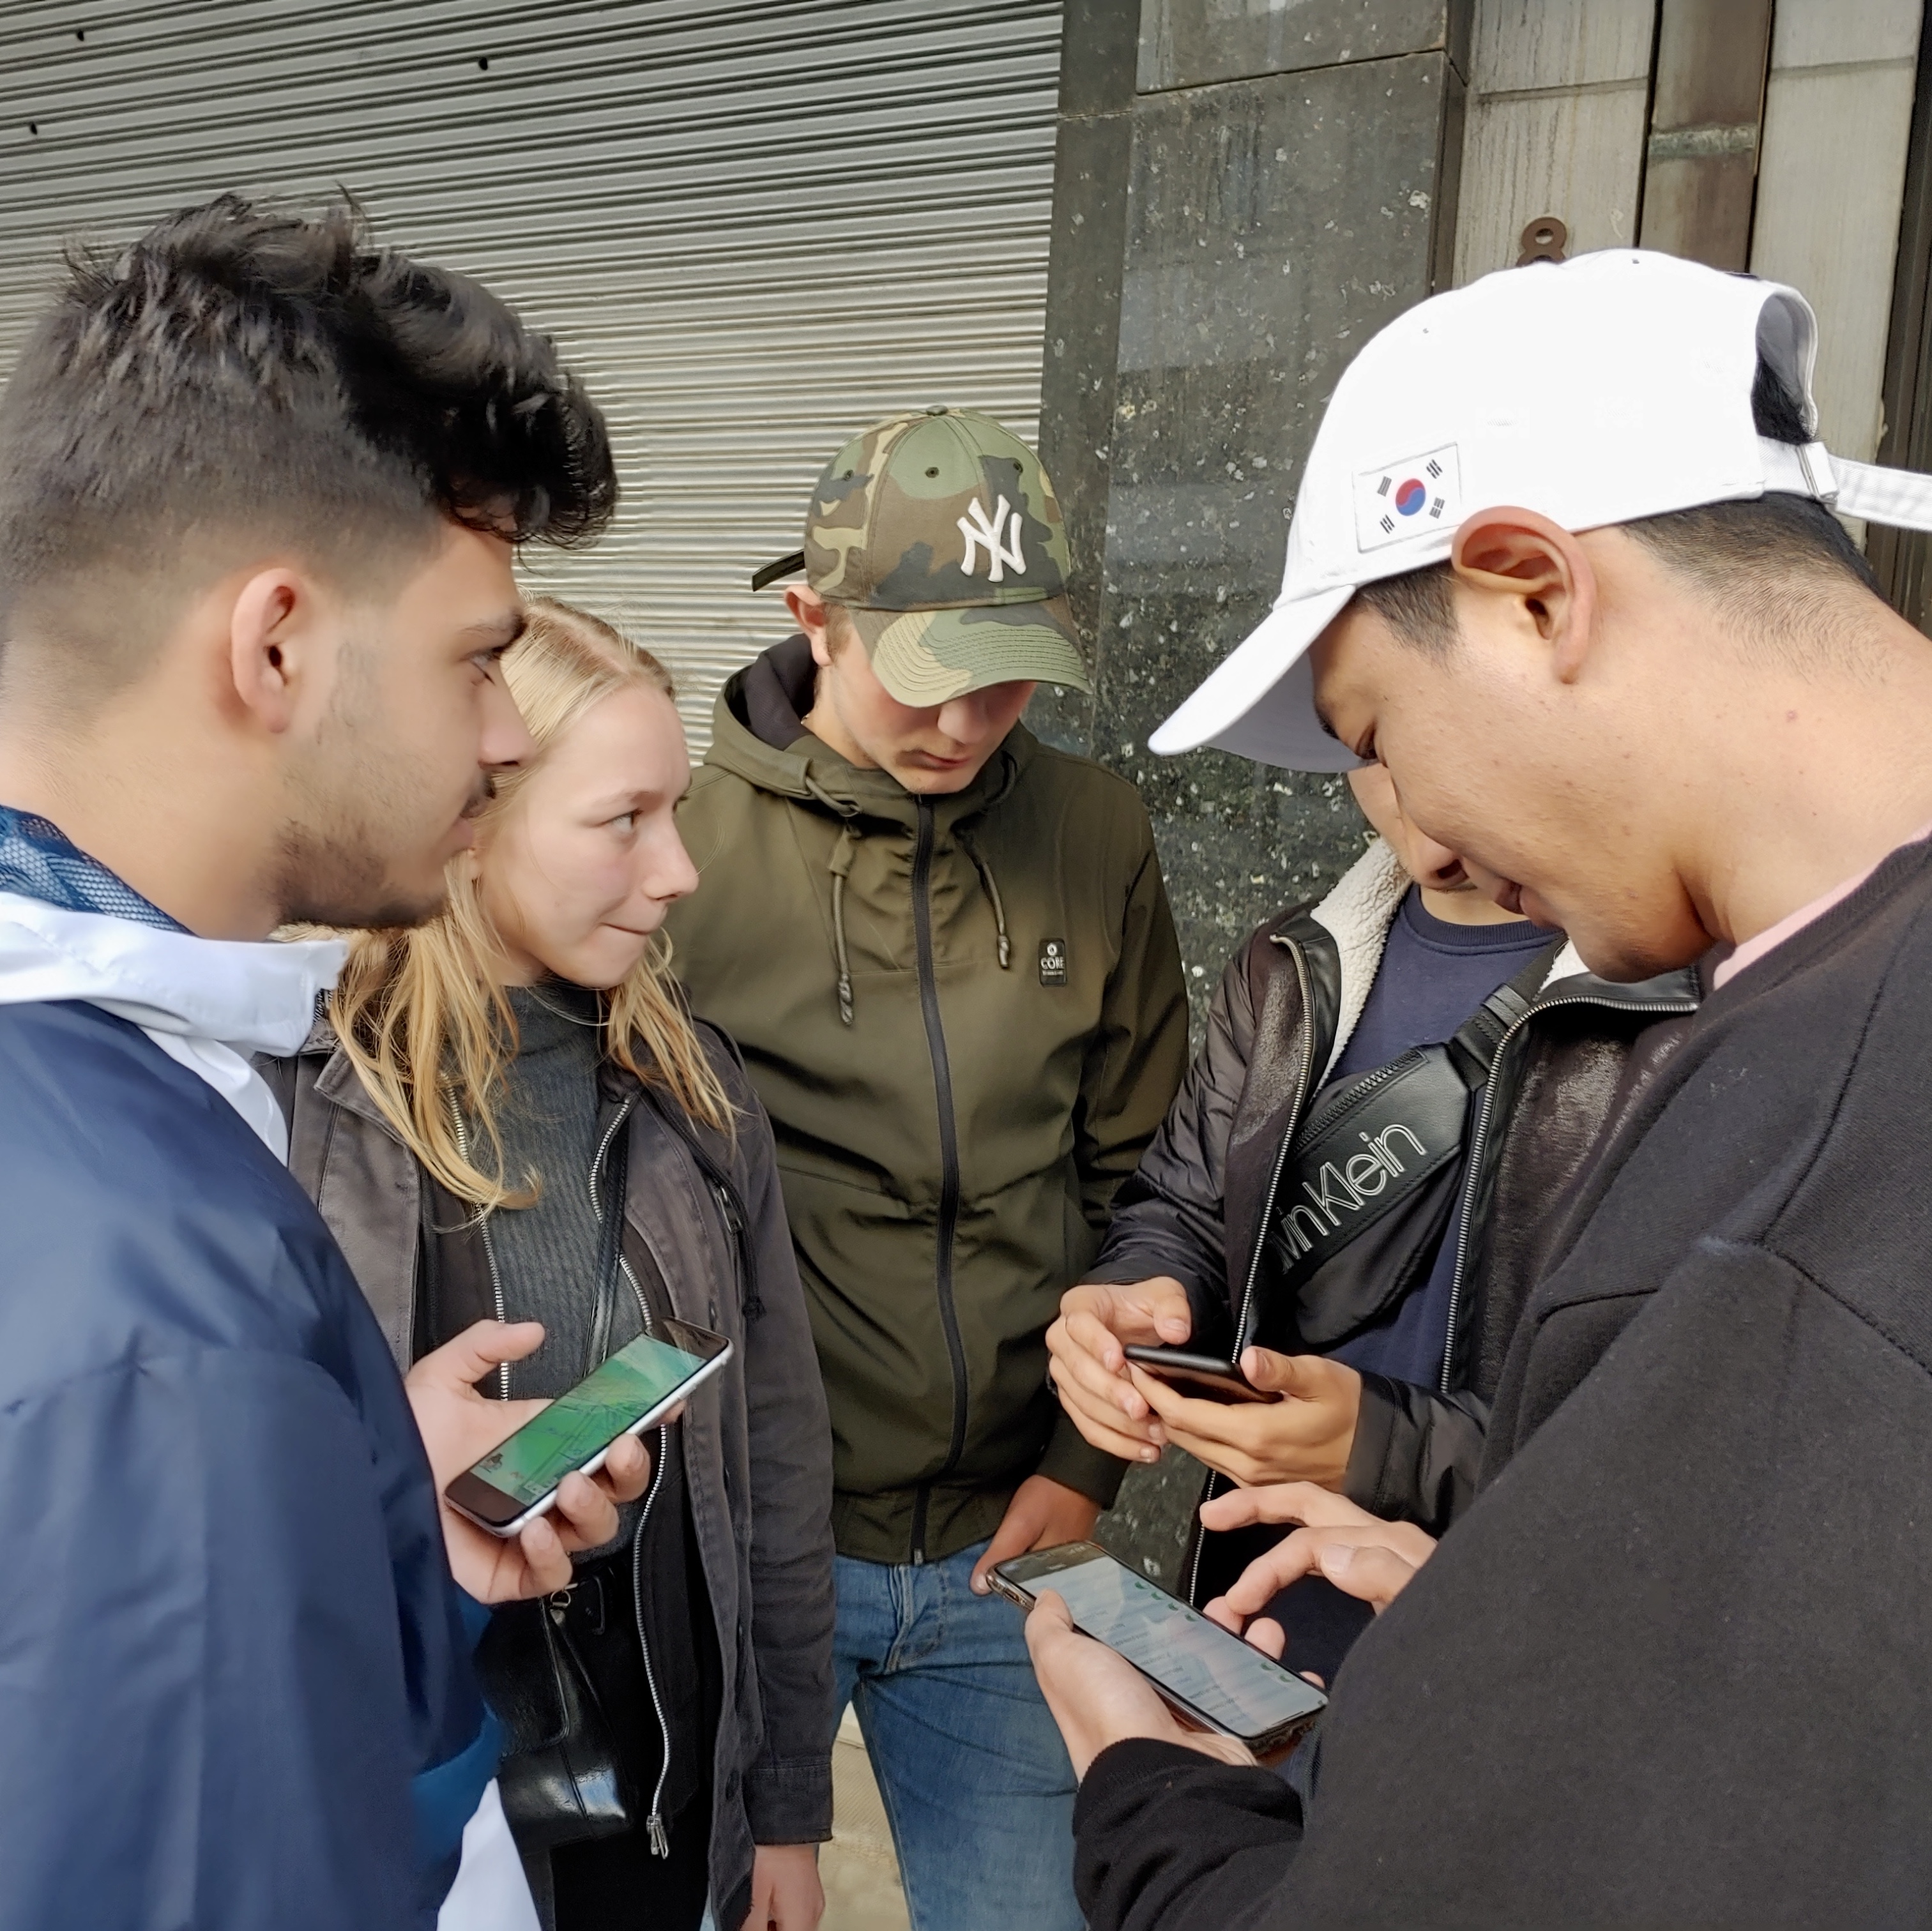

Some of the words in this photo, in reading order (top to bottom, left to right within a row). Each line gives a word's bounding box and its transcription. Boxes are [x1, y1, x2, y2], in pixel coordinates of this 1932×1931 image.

[957, 494, 1026, 582] NY
[1040, 957, 1065, 969] CORE
[1302, 1123, 1427, 1227] Klein
